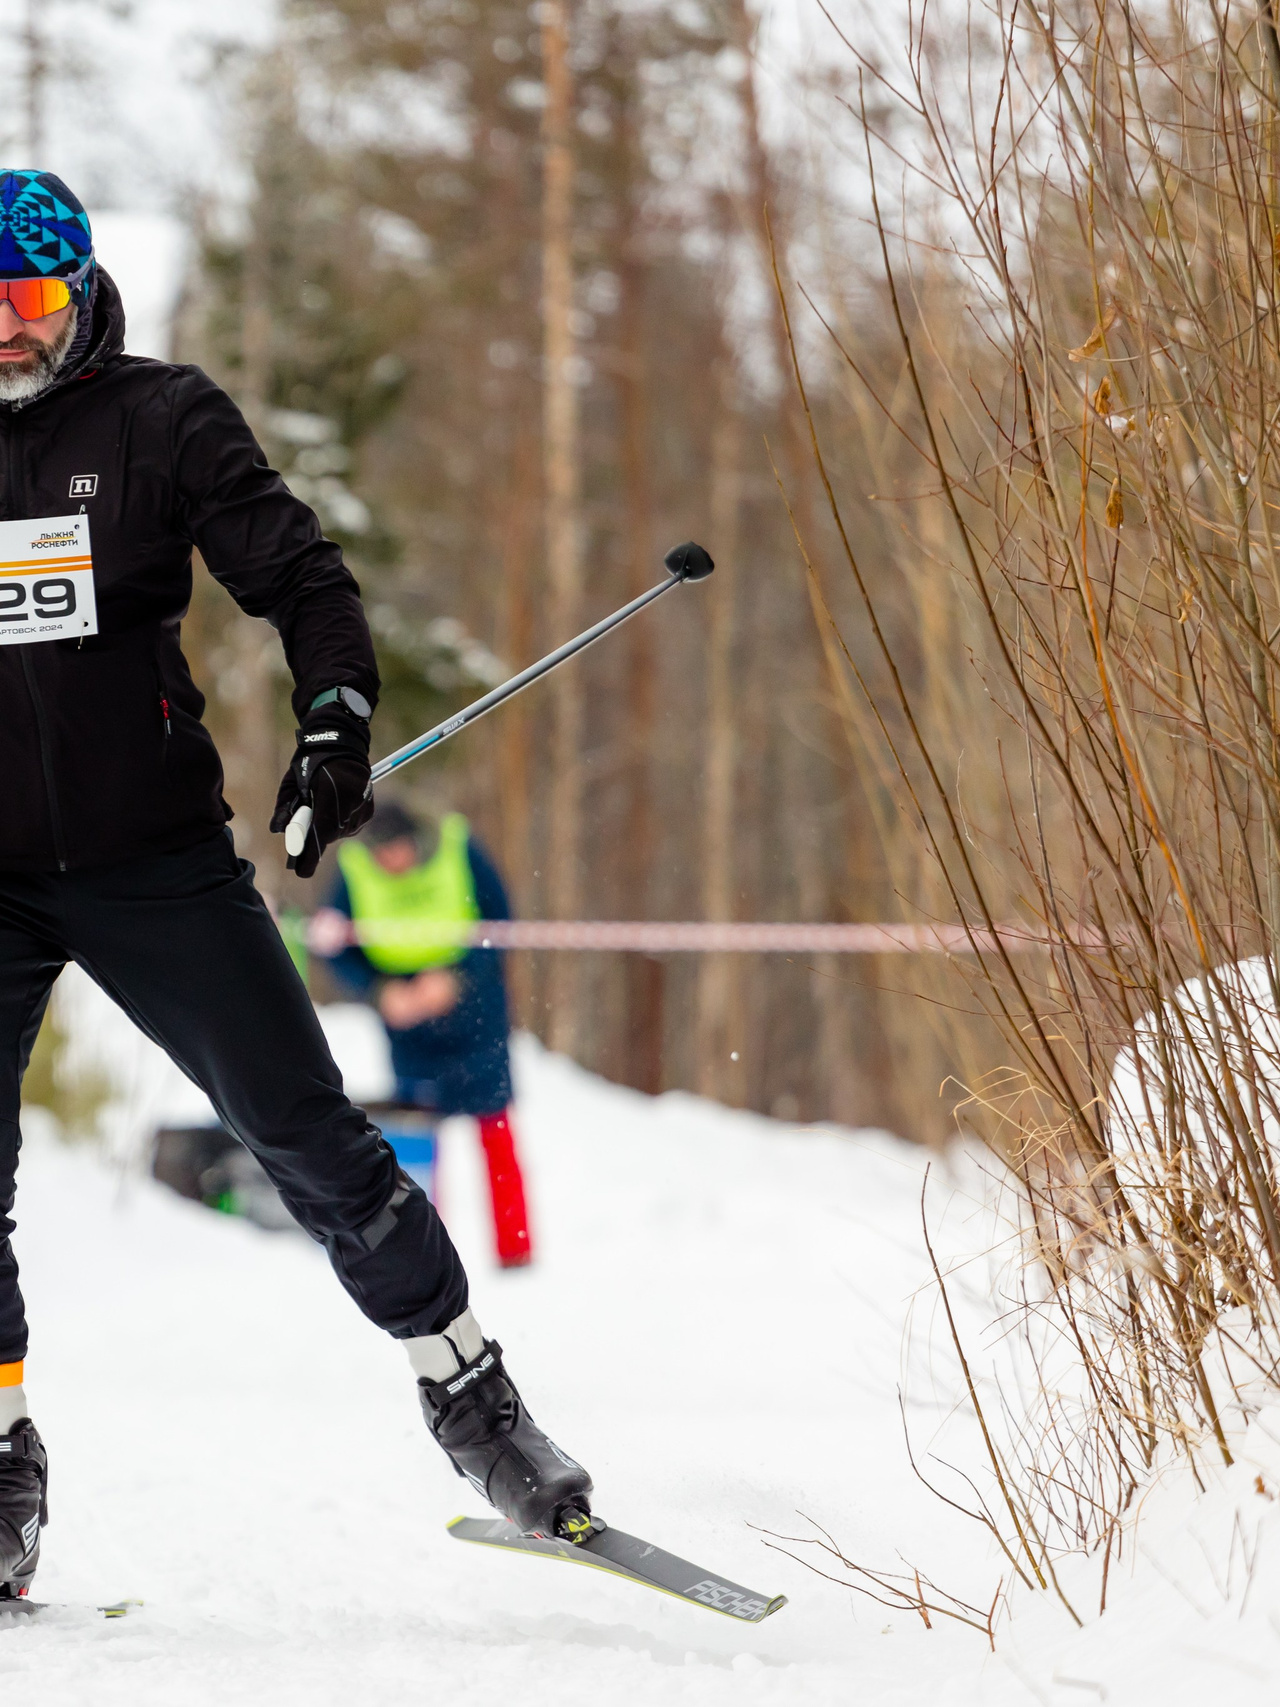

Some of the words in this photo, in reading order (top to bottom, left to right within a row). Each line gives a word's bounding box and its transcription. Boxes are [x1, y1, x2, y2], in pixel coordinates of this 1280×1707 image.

[40, 531, 74, 540] ЛЫЖНЯ
[31, 539, 78, 549] РОСНЕФТИ
[39, 624, 63, 632] 2024
[446, 1352, 494, 1394] SPINE
